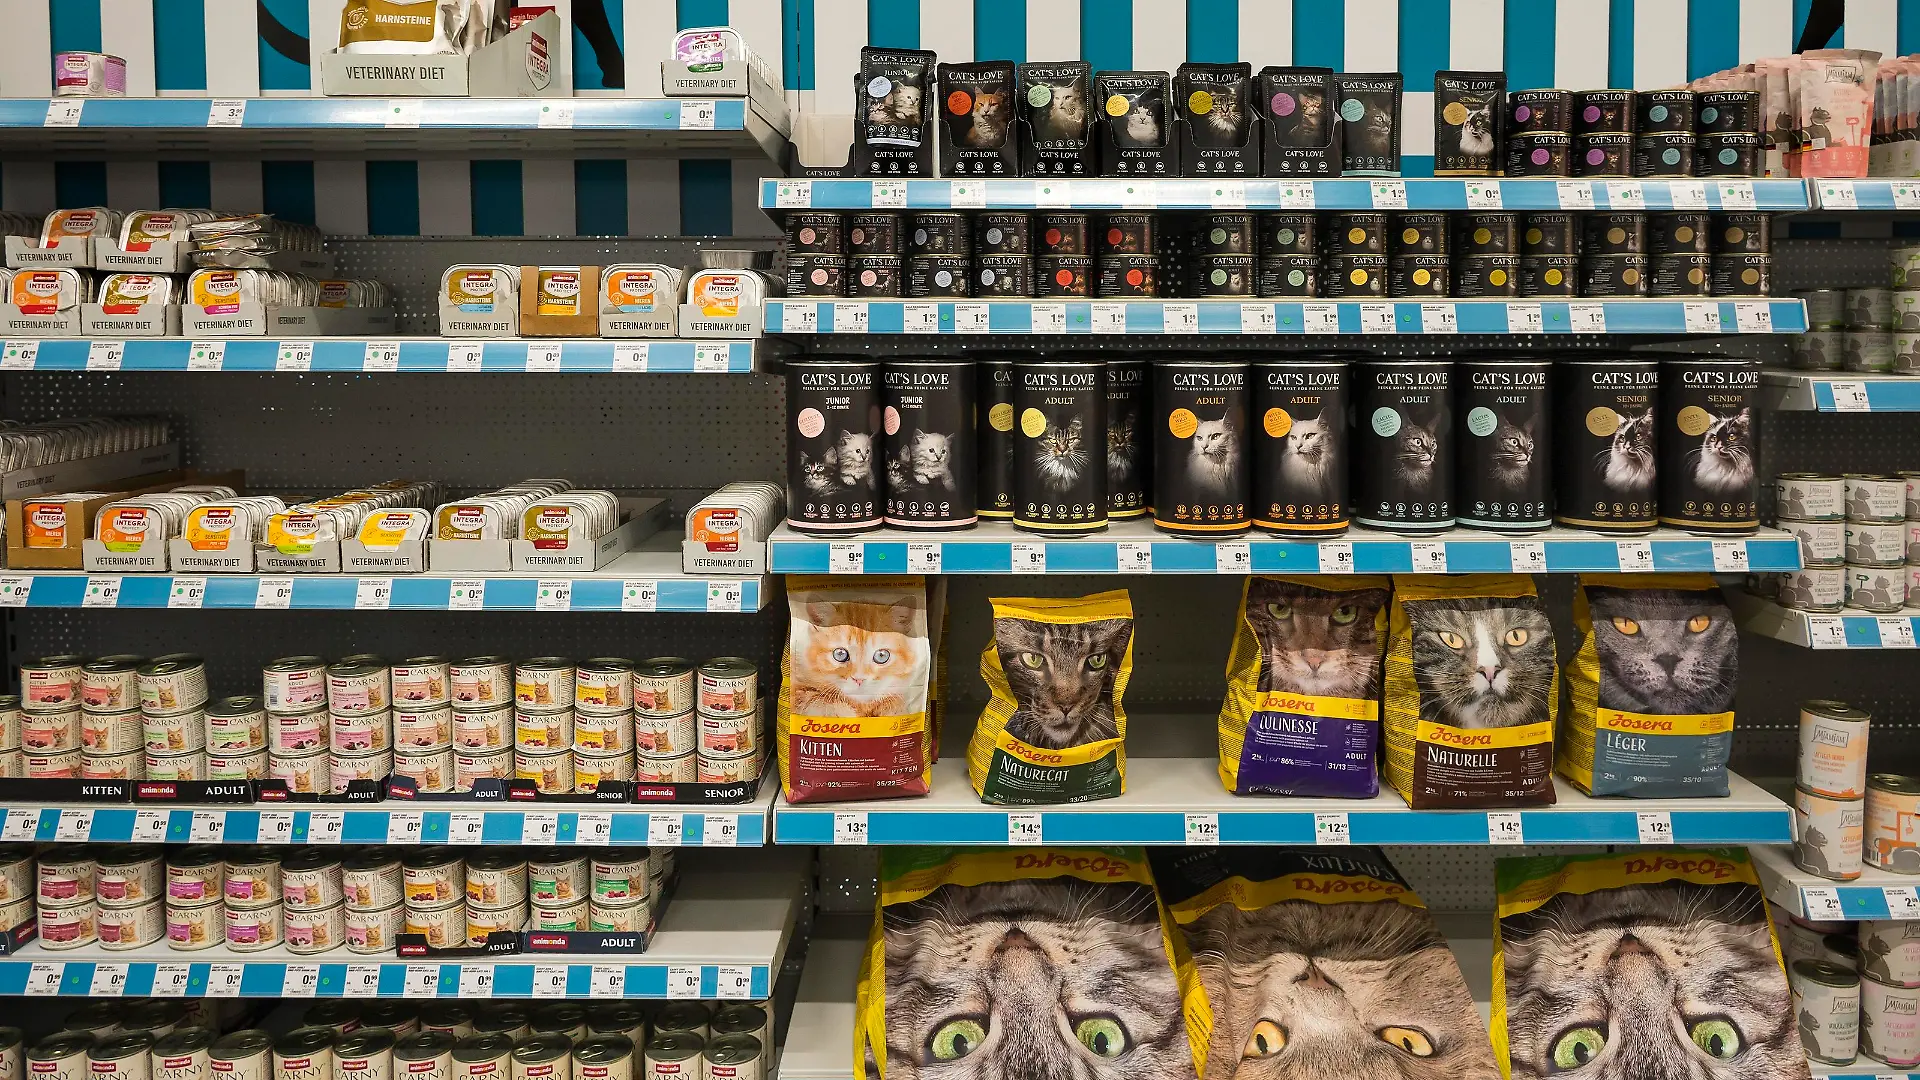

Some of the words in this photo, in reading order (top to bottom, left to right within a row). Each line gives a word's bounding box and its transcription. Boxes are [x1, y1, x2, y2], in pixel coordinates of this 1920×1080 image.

[375, 13, 431, 26] HARNSTEINE
[345, 66, 416, 80] VETERINARY
[419, 67, 445, 80] DIET
[949, 71, 976, 81] CAT'S
[979, 70, 1003, 80] LOVE
[1189, 72, 1214, 82] CAT'S
[1216, 72, 1240, 82] LOVE
[675, 79, 718, 89] VETERINARY
[720, 79, 737, 88] DIET
[1273, 75, 1297, 83] CAT'S
[1298, 75, 1323, 84] LOVE
[1444, 79, 1469, 90] CAT'S
[1471, 80, 1495, 90] LOVE
[1342, 81, 1367, 90] CAT'S
[1368, 81, 1394, 90] LOVE
[1517, 93, 1537, 102] CAT'S
[1539, 92, 1560, 101] LOVE
[1586, 93, 1606, 102] CAT'S
[1607, 92, 1630, 101] LOVE
[1121, 150, 1141, 158] CAT'S
[16, 252, 56, 262] VETERINARY
[57, 252, 73, 262] DIET
[105, 255, 146, 265] VETERINARY
[147, 255, 163, 265] DIET
[983, 257, 1002, 265] CAT'S
[1004, 257, 1022, 265] LOVE
[1213, 257, 1233, 265] CAT'S
[1234, 257, 1252, 265] LOVE
[208, 281, 239, 289] INTEGRA
[463, 281, 494, 289] INTEGRA
[622, 281, 654, 289] INTEGRA
[8, 320, 51, 330] VETERINARY
[53, 320, 69, 329] DIET
[91, 321, 133, 330] VETERINARY
[135, 321, 151, 330] DIET
[448, 322, 492, 331] VETERINARY
[492, 322, 509, 331] DIET
[609, 322, 652, 330] VETERINARY
[654, 322, 670, 331] DIET
[801, 373, 836, 385] CAT'S
[841, 373, 872, 385] LOVE
[884, 373, 909, 385] CAT'S
[913, 373, 949, 385] LOVE
[1024, 373, 1058, 386] CAT'S
[1061, 373, 1096, 386] LOVE
[1173, 373, 1210, 386] CAT'S
[1214, 373, 1244, 385] LOVE
[1267, 373, 1305, 386] CAT'S
[1308, 373, 1340, 385] LOVE
[1376, 372, 1413, 385] CAT'S
[1418, 372, 1448, 384] LOVE
[1472, 372, 1510, 385] CAT'S
[1514, 372, 1546, 384] LOVE
[1592, 372, 1632, 384] CAT'S
[1635, 372, 1659, 384] LOVE
[1683, 371, 1725, 384] CAT'S
[1728, 371, 1758, 383] LOVE
[825, 396, 850, 405] JUNIOR
[900, 396, 924, 404] JUNIOR
[1045, 397, 1075, 405] ADULT
[1196, 396, 1226, 405] ADULT
[1290, 396, 1321, 404] ADULT
[1400, 395, 1430, 403] ADULT
[1496, 395, 1527, 403] ADULT
[1616, 395, 1647, 403] SENIOR
[1708, 395, 1742, 403] SENIOR
[116, 519, 147, 527] INTEGRA
[95, 557, 139, 566] VETERINARY
[140, 557, 155, 566] DIET
[351, 557, 393, 566] VETERINARY
[394, 558, 410, 566] DIET
[525, 556, 567, 565] VETERINARY
[568, 556, 584, 565] DIET
[694, 558, 736, 568] VETERINARY
[738, 559, 754, 568] DIET
[410, 667, 442, 676] CARNY
[460, 667, 492, 676] CARNY
[348, 677, 380, 687] CARNY
[589, 673, 623, 682] CARNY
[718, 678, 750, 687] CARNY
[1261, 693, 1316, 712] Josera
[229, 715, 262, 726] CARNY
[1608, 714, 1673, 731] Josera
[800, 719, 861, 734] Josera
[1430, 727, 1492, 746] Josera
[1607, 732, 1646, 752] LÉGER
[800, 738, 843, 757] KITTEN
[1005, 740, 1063, 764] Josera
[1345, 753, 1367, 761] ADULT
[1427, 746, 1498, 768] NATURELLE
[891, 765, 918, 775] KITTEN
[1328, 762, 1347, 771] 31/13
[1633, 775, 1647, 783] 90%
[82, 785, 122, 796] KITTEN
[141, 786, 174, 794] animonda
[205, 785, 246, 796] ADULT
[348, 790, 375, 799] ADULT
[475, 790, 499, 798] ADULT
[640, 788, 673, 797] animonda
[705, 787, 744, 798] SENIOR
[1454, 790, 1468, 798] 71%
[1500, 821, 1520, 832] 14.49
[57, 865, 92, 876] CARNY
[611, 866, 641, 875] CARNY
[1014, 854, 1130, 877] Josera
[1625, 859, 1736, 879] Josera
[235, 866, 268, 876] CARNY
[416, 869, 449, 878] CARNY
[488, 942, 515, 951] ADULT
[533, 937, 566, 946] animonda
[601, 937, 636, 948] ADULT
